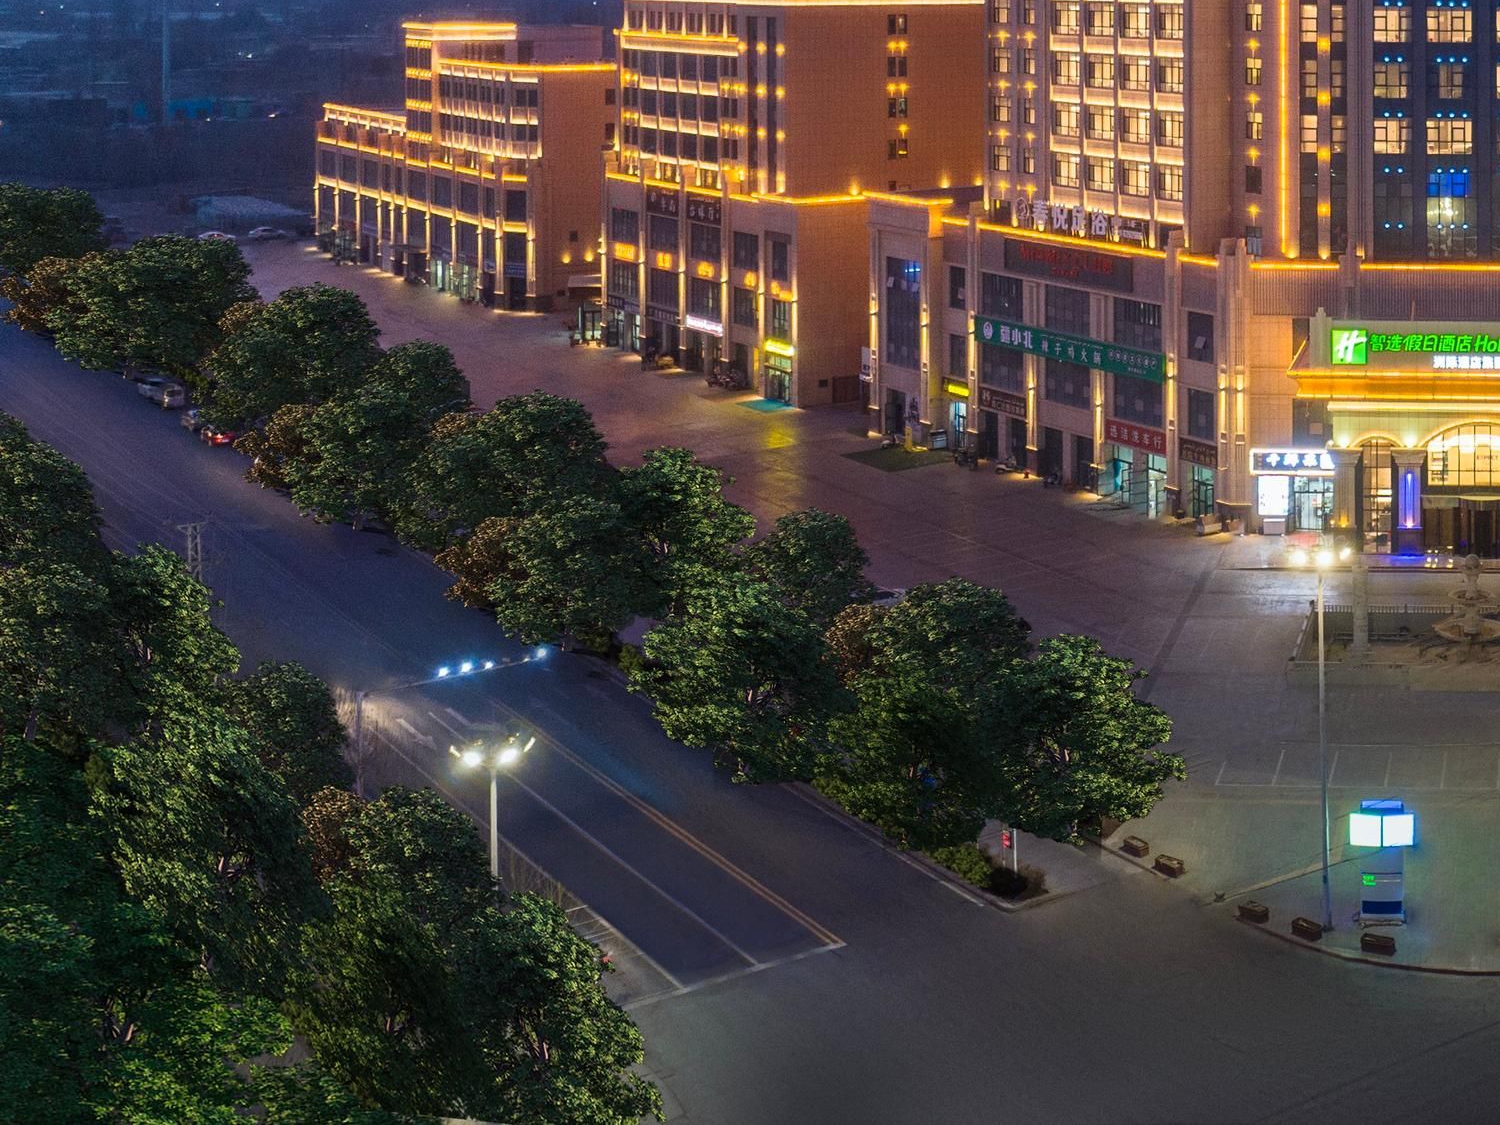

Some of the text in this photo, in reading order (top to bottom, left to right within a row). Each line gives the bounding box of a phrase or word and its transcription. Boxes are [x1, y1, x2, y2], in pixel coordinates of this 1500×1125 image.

[1369, 333, 1473, 352] 智选假日酒店
